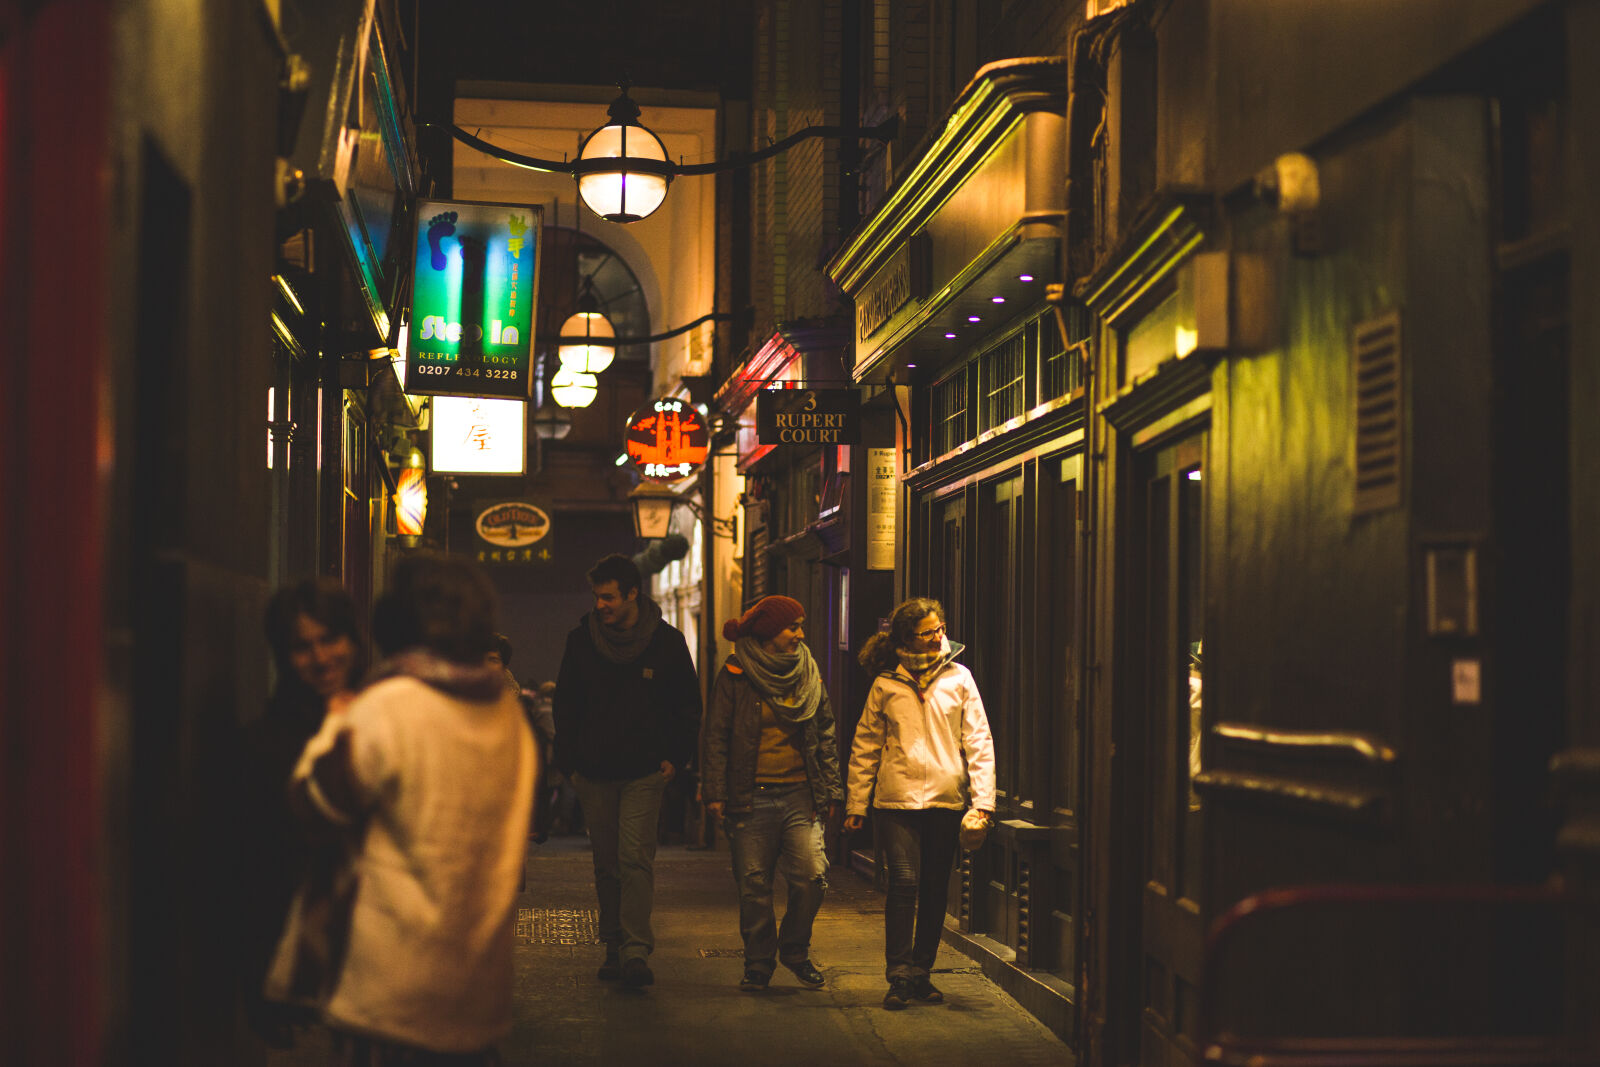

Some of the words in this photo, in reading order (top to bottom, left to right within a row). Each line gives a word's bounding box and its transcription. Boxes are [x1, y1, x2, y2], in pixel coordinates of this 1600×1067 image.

[419, 314, 483, 348] Step
[489, 319, 520, 345] In
[418, 365, 451, 376] 0207
[456, 367, 481, 377] 434
[485, 369, 518, 380] 3228
[803, 390, 817, 411] 3
[775, 413, 848, 428] RUPERT
[779, 429, 842, 443] COURT
